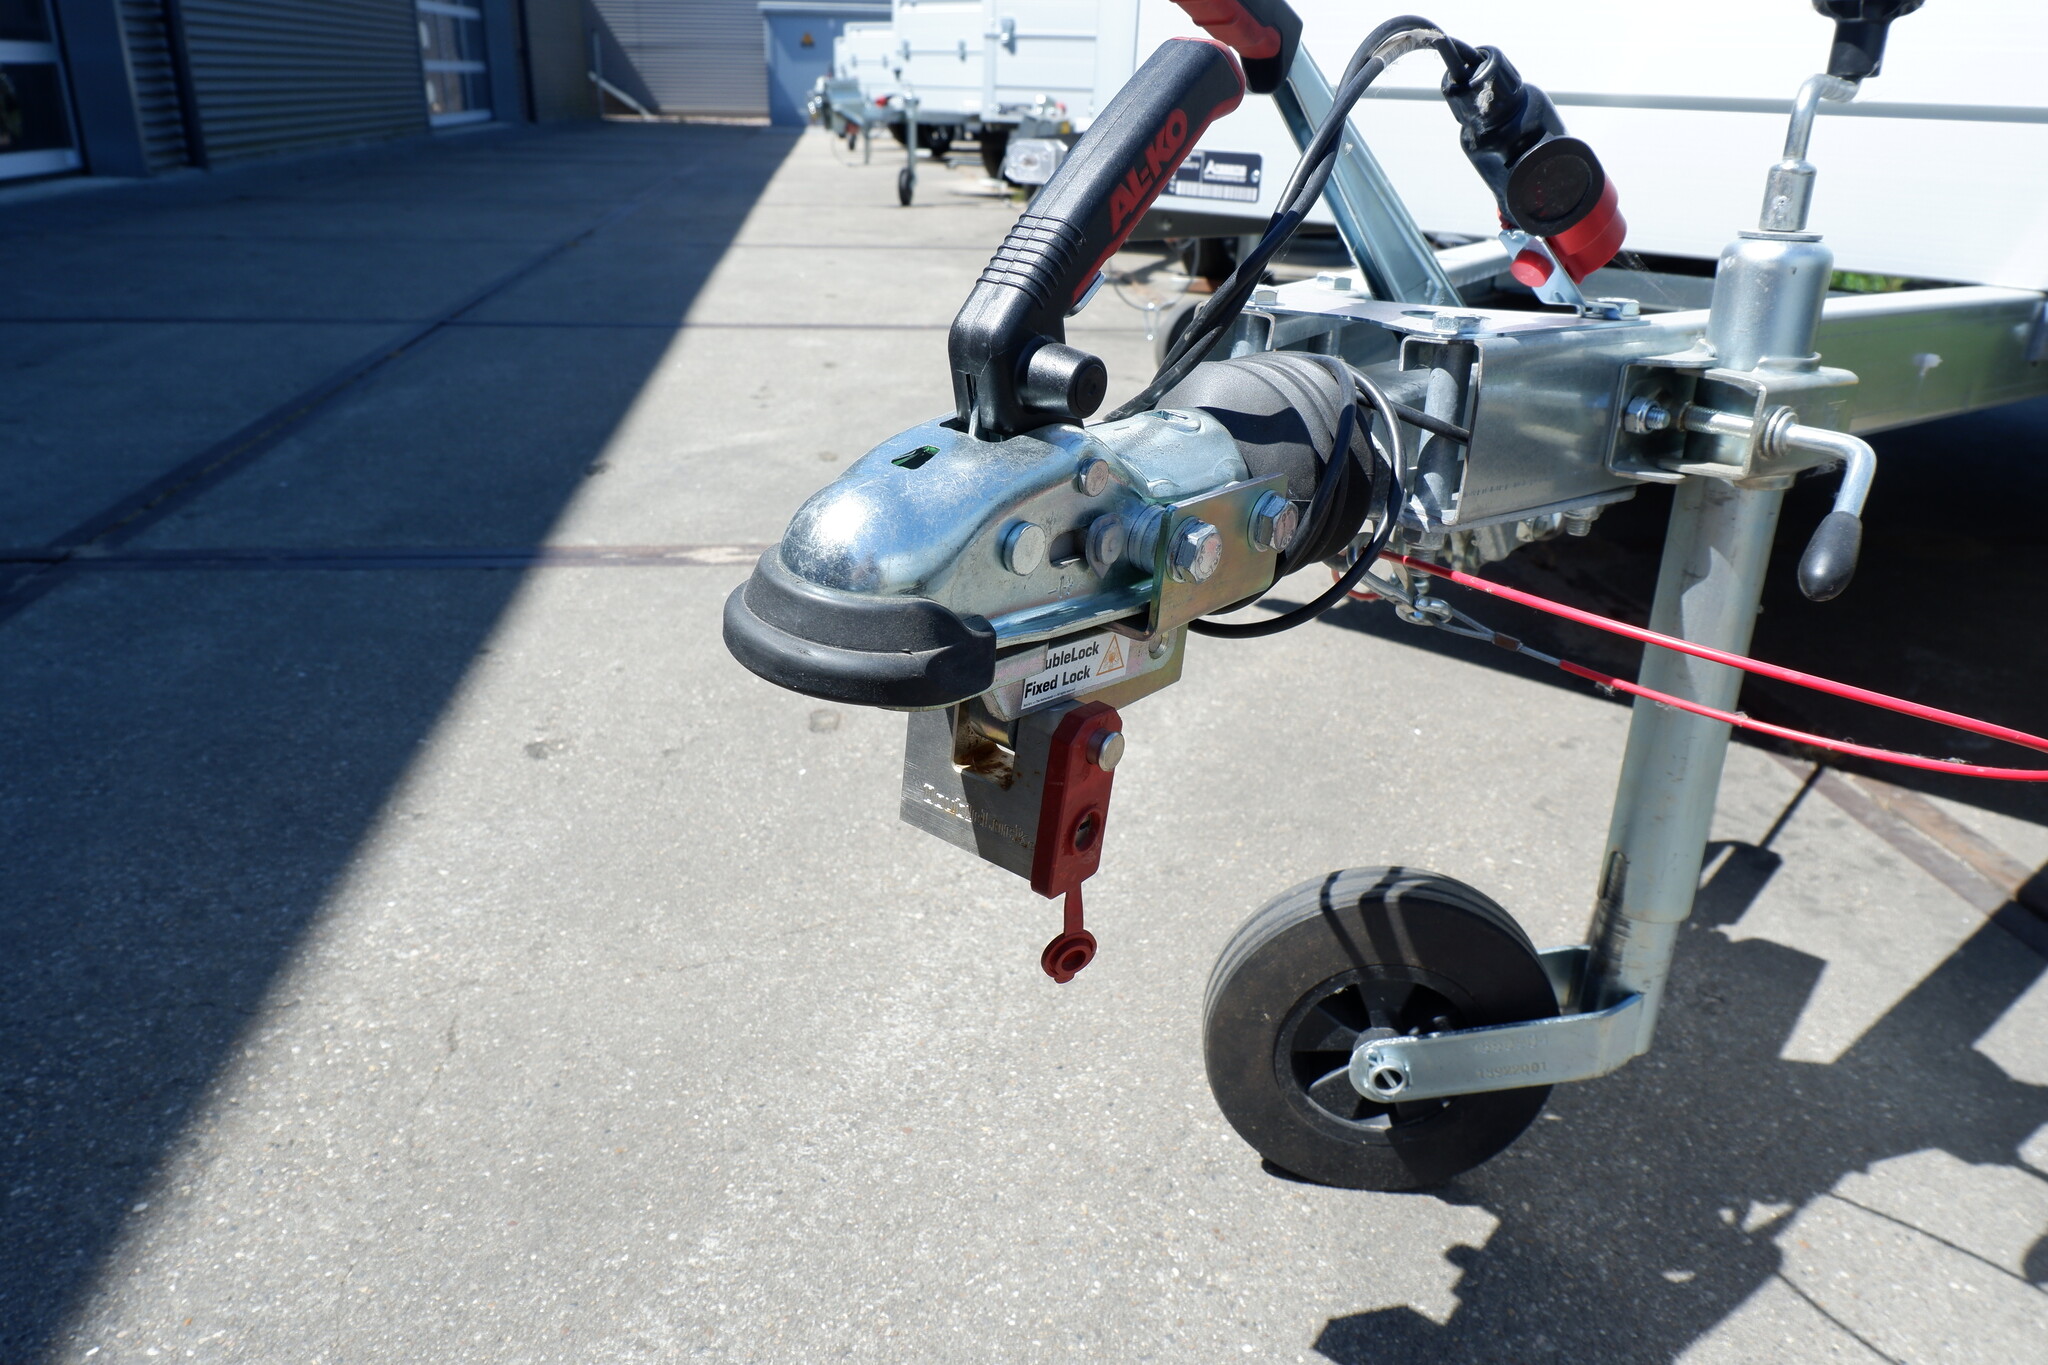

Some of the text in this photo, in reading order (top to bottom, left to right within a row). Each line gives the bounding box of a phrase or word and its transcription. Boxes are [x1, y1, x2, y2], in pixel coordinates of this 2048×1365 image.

[1109, 108, 1187, 236] AL-KO
[1045, 641, 1099, 670] ubleLock
[1024, 674, 1058, 698] Fixed
[1062, 665, 1091, 687] Lock
